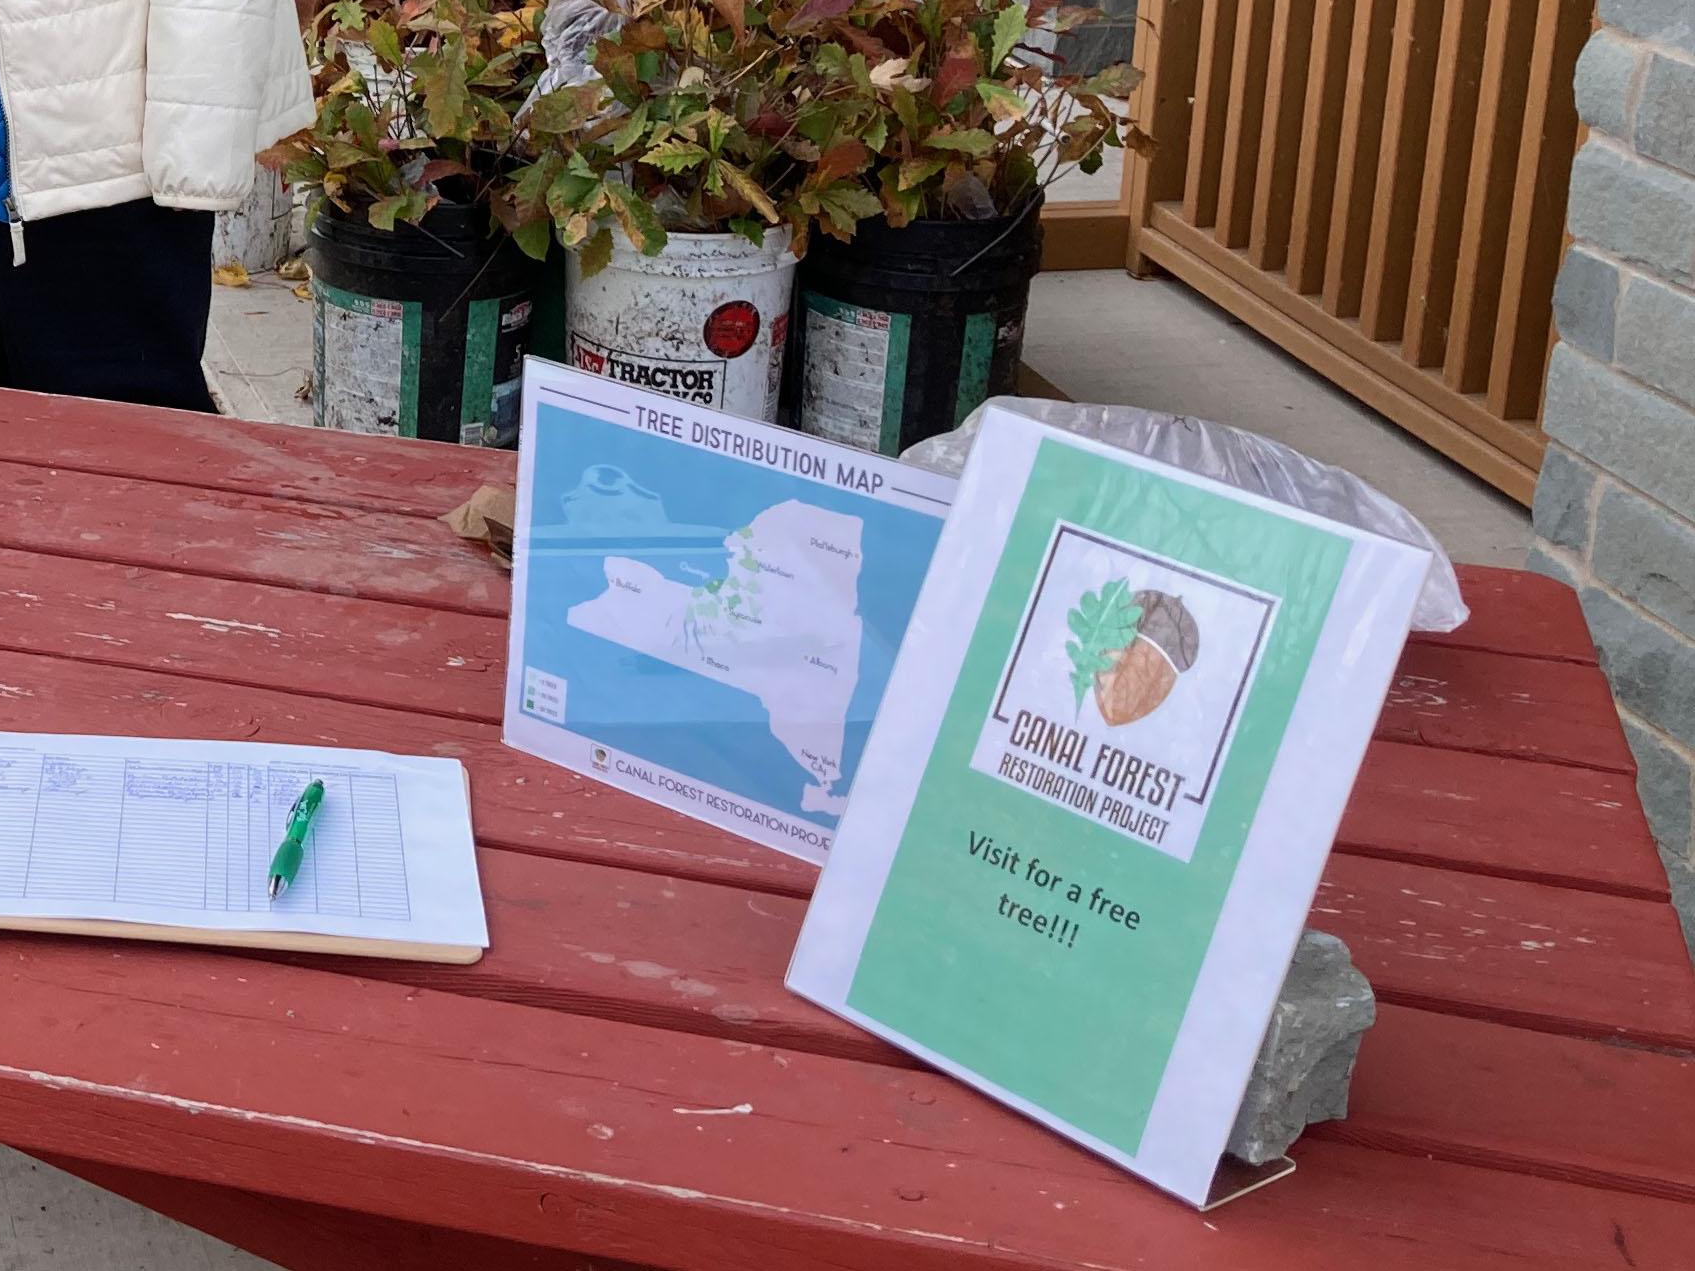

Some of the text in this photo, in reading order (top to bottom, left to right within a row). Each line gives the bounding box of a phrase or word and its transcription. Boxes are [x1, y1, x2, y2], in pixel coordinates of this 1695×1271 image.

[607, 357, 715, 390] TRACTOR
[635, 405, 883, 494] TREE DISTRIBUTION MAP
[616, 759, 656, 786] CANAL
[658, 775, 704, 803] FOREST
[706, 793, 789, 835] RESTORATION
[997, 752, 1170, 845] RESTORATION PROJECT
[1008, 709, 1186, 813] CANAL FOREST
[968, 830, 1141, 931] Visit for a free
[997, 892, 1080, 949] tree!!!
